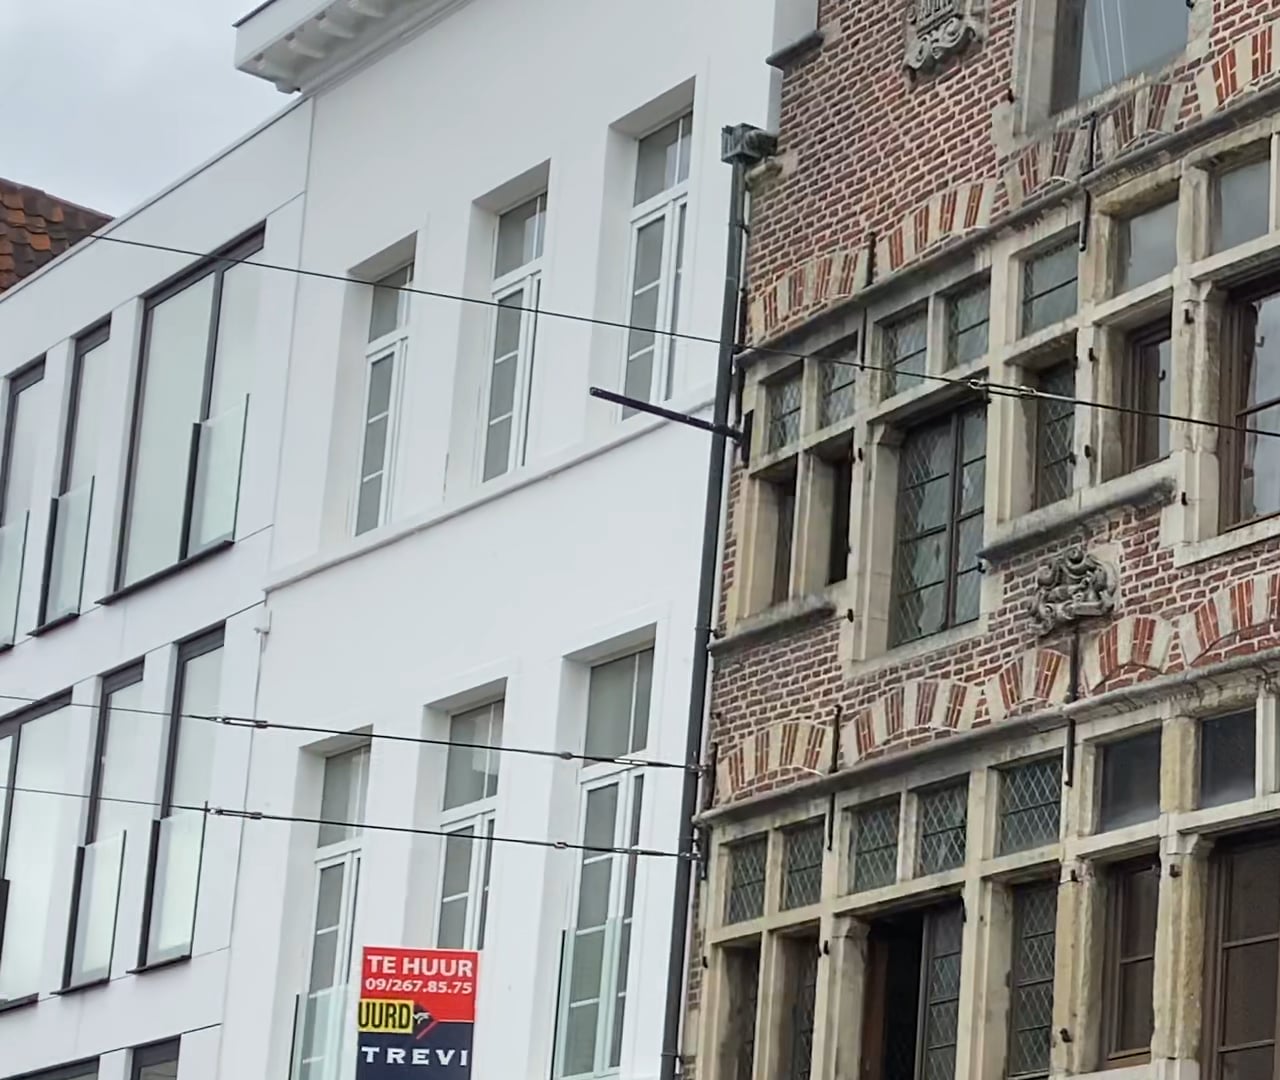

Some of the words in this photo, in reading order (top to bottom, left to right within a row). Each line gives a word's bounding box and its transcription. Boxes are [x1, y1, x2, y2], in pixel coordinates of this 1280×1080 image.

[367, 955, 397, 974] TE
[402, 957, 473, 978] HUUR
[365, 978, 473, 994] 09/267.85.75
[361, 1046, 468, 1066] TREVI
